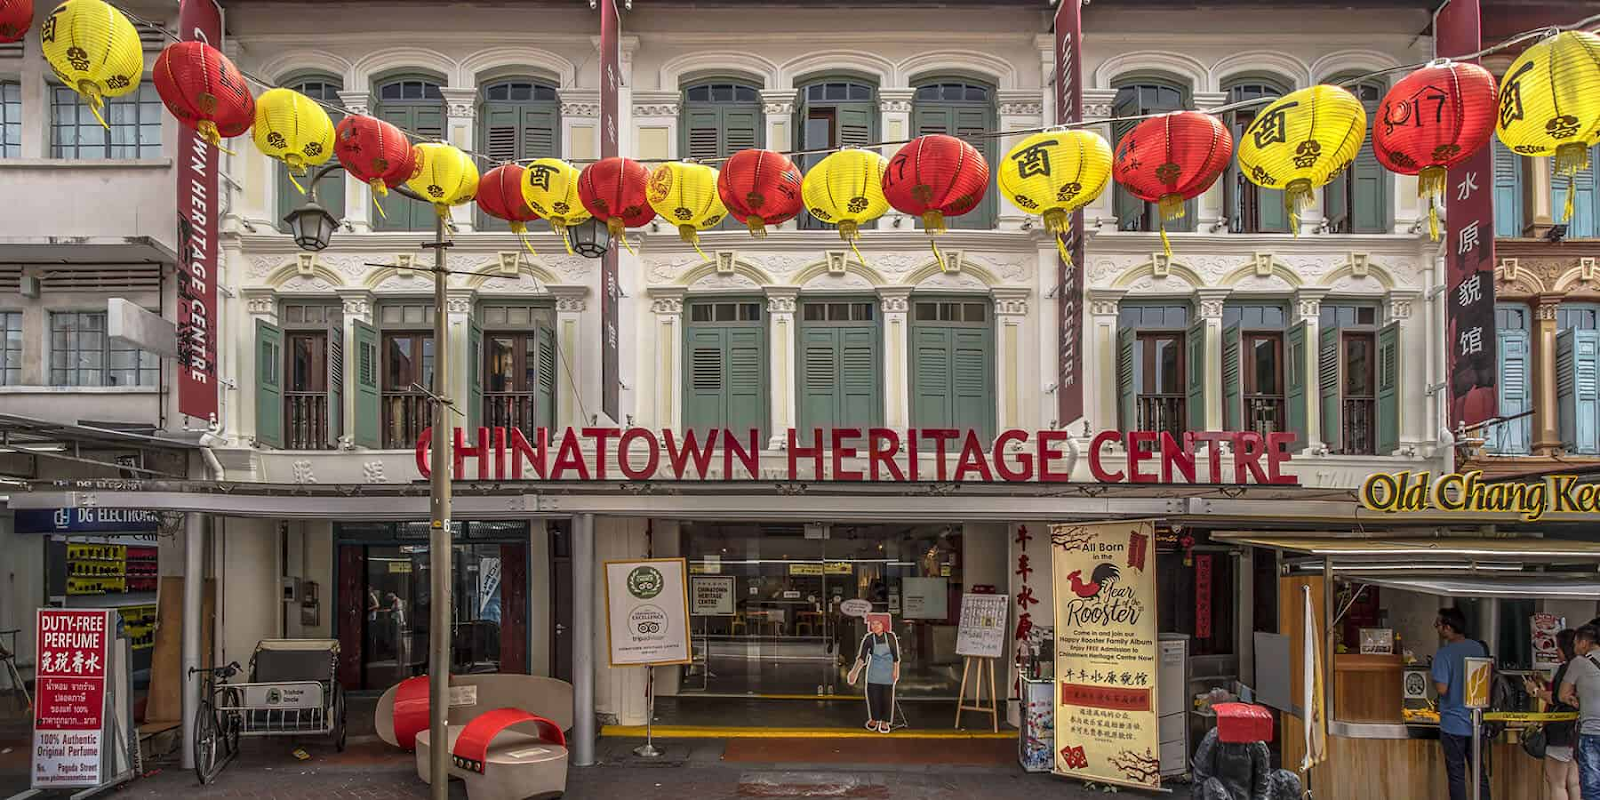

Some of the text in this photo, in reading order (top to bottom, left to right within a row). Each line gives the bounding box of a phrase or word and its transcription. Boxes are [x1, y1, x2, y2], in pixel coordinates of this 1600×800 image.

[1247, 101, 1299, 149] 酉
[1010, 139, 1059, 180] 酉
[528, 164, 560, 193] 酉
[190, 179, 207, 294] HERITAGE
[190, 299, 207, 384] CENTRE
[1064, 299, 1075, 388] CENTRE
[415, 426, 760, 480] CHINATOWN
[788, 427, 1068, 482] HERITAGE
[1088, 430, 1298, 485] CENTRE
[1360, 470, 1430, 513] Old
[1430, 470, 1550, 522] Chang
[78, 507, 93, 523] DG
[444, 518, 450, 533] 6
[1082, 542, 1124, 552] All Born
[1103, 581, 1136, 603] Year
[1067, 598, 1141, 627] Rooster
[42, 615, 104, 632] DUTY-FREE
[44, 632, 100, 649] PERFUME
[1060, 636, 1080, 644] Happy
[1106, 638, 1128, 646] Family
[1129, 638, 1153, 646] Album
[1070, 645, 1086, 653] Enjoy
[41, 650, 102, 675] 免税香水
[1088, 653, 1114, 661] Heritage
[41, 733, 97, 745] 100% Authentic
[37, 746, 98, 759] Original Perfume
[58, 763, 78, 774] Pagoda
[80, 763, 97, 772] Street
